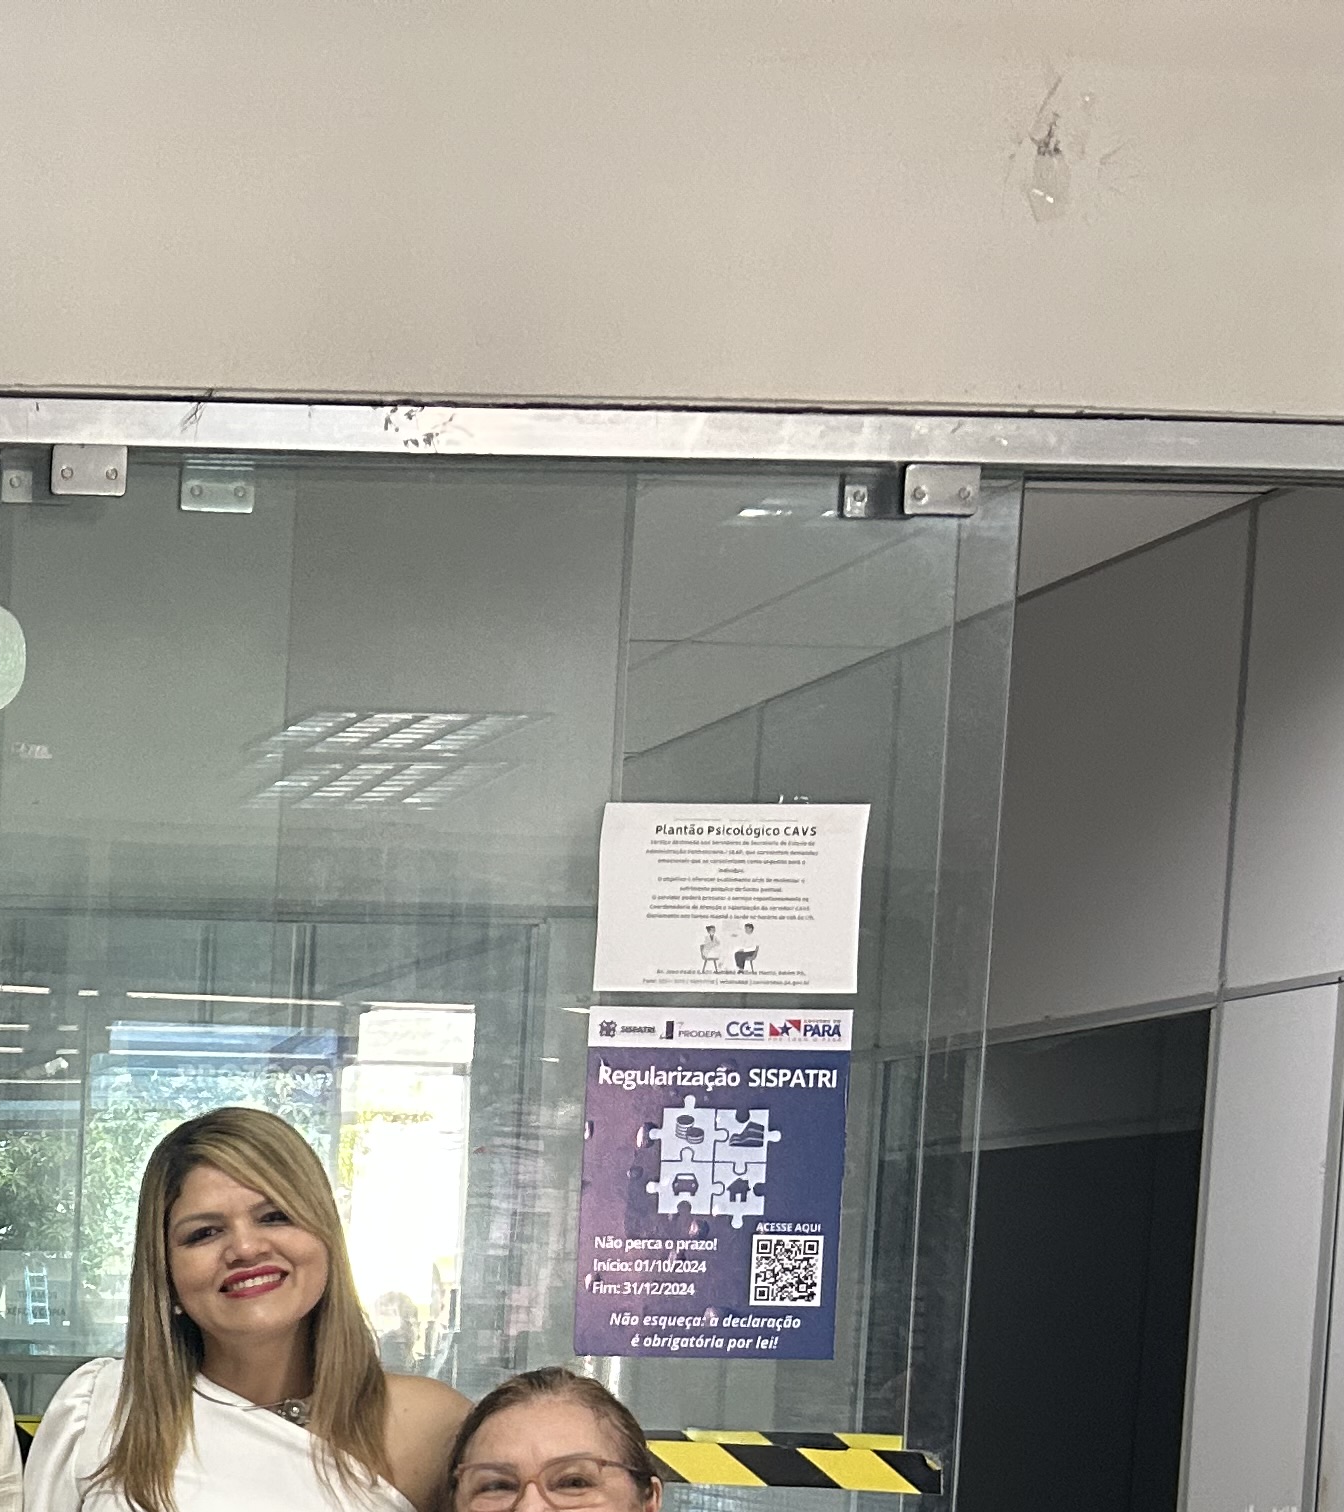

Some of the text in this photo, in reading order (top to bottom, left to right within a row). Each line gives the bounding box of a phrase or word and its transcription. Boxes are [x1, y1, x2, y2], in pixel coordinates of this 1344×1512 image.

[655, 824, 817, 838] Plantão Psicológico CAVS
[678, 1030, 722, 1039] PRODEPA
[598, 1064, 838, 1092] Regularização SISPATRI
[756, 1222, 821, 1234] ACESSE AQUI
[594, 1236, 718, 1253] Não perca o prazo!
[593, 1258, 707, 1273] Início: 01/10/2024
[592, 1281, 696, 1296] Fim: 31/12/2024
[609, 1312, 639, 1326] Não
[723, 1314, 802, 1331] declaração
[631, 1333, 779, 1352] é obrigatória por lei!
